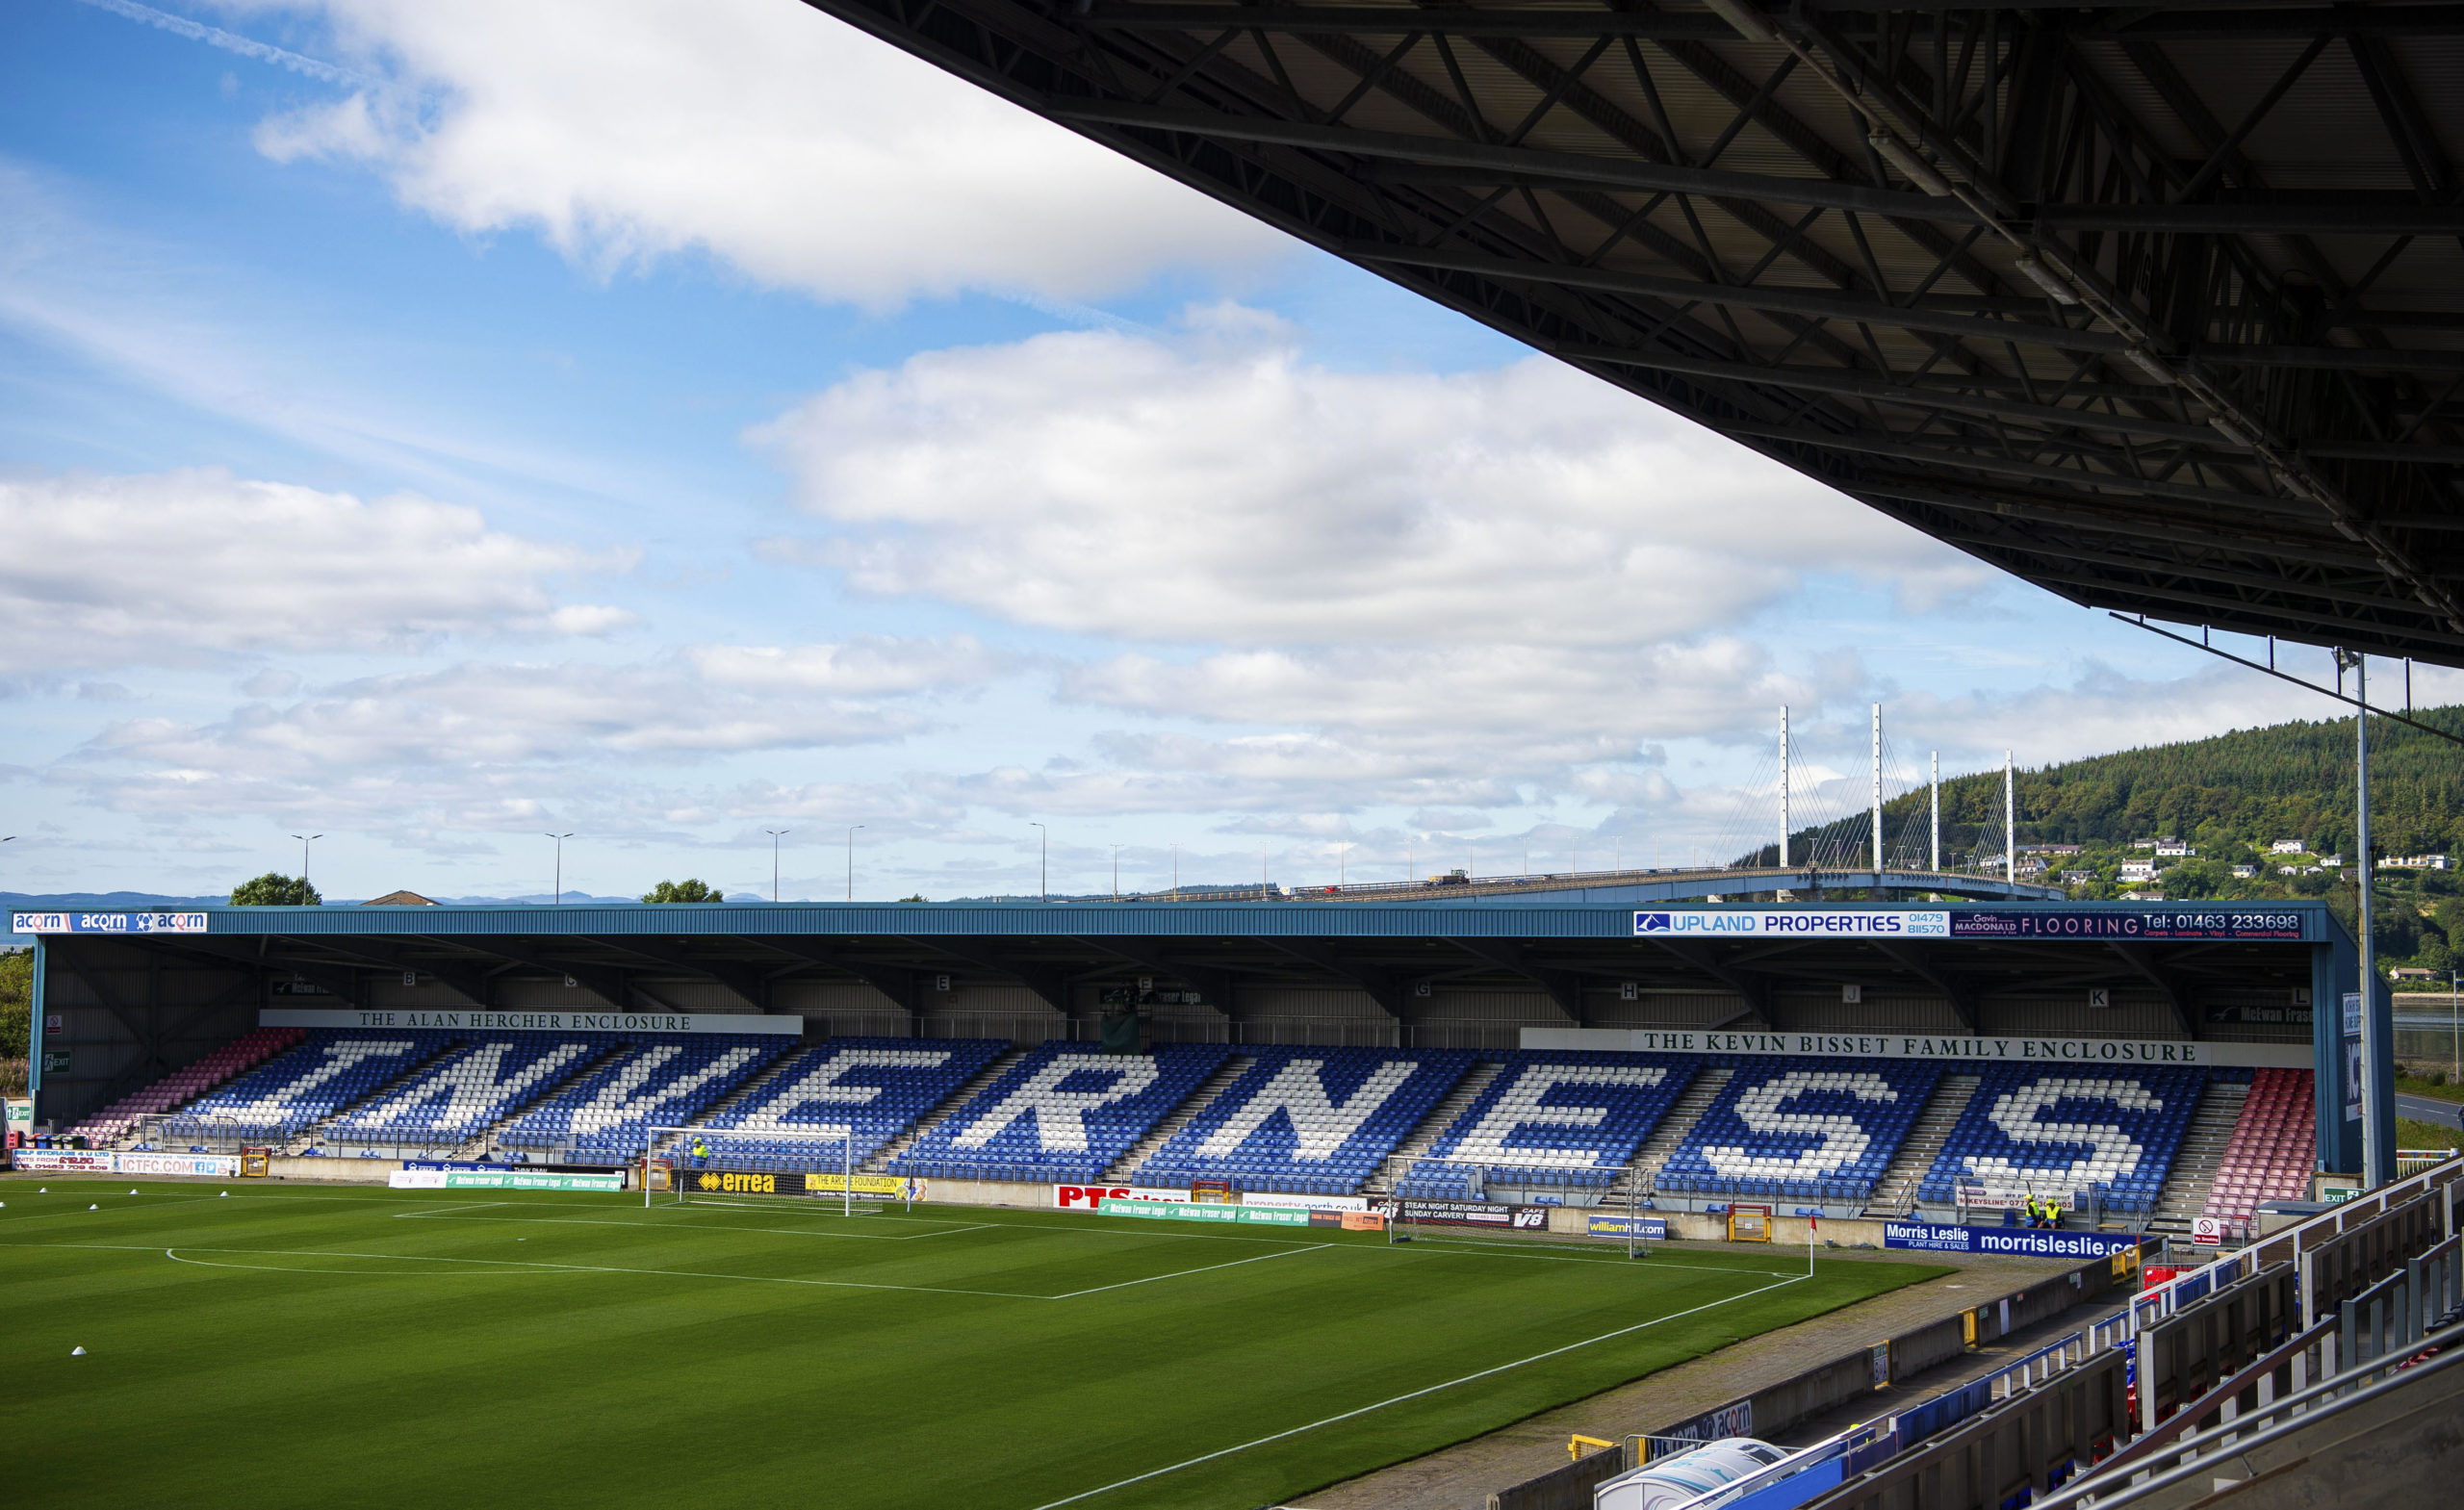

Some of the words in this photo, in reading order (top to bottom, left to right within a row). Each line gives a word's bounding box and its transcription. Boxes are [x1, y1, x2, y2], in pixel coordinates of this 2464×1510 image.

[16, 914, 60, 930] acorn
[81, 913, 126, 930] acorn
[158, 914, 204, 930] acorn
[1674, 915, 1756, 932] UPLAND
[1765, 915, 1901, 932] PROPERTIES
[1909, 913, 1943, 923] 01479
[1973, 914, 1997, 923] Gavin
[2022, 917, 2139, 934] FLOORING
[2143, 914, 2170, 929] Tel:
[2176, 914, 2226, 929] 01463
[2231, 914, 2298, 930] 233698
[1908, 924, 1945, 934] 811570
[405, 973, 414, 985] B
[939, 977, 947, 989] E
[1418, 982, 1428, 995] G
[1624, 985, 1634, 998] H
[2092, 990, 2105, 1005] K
[2296, 989, 2307, 1004] L
[360, 1012, 396, 1025] THE
[406, 1012, 460, 1027] ALAN
[469, 1013, 562, 1029] HERCHER
[571, 1014, 692, 1030] ENCLOSURE
[2241, 1007, 2283, 1022] McEwan
[2286, 1007, 2314, 1022] Frase
[1644, 1033, 1695, 1049] THE
[1706, 1034, 1786, 1052] KEVIN
[1799, 1036, 1889, 1054] BISSET
[1903, 1037, 2010, 1057] FAMILY
[2021, 1040, 2196, 1062] ENCLOSURE
[54, 1058, 69, 1066] EXIT
[122, 1159, 193, 1173] ICTFC.COM
[723, 1172, 775, 1192] errea
[817, 1175, 829, 1185] THE
[831, 1175, 854, 1186] ARCHE
[855, 1176, 897, 1188] FOUNDATION
[1958, 1197, 2008, 1206] "MKEYSLINE"
[2324, 1193, 2346, 1203] EXIT
[1110, 1203, 1132, 1214] McEwan
[1133, 1204, 1151, 1215] Fraser
[1152, 1205, 1166, 1216] Legal
[1178, 1205, 1201, 1217] McEwan
[1202, 1207, 1219, 1218] Fraser
[1220, 1209, 1236, 1220] Legal
[1427, 1202, 1450, 1211] NIGHT
[1450, 1203, 1486, 1212] SATURDAY
[1487, 1205, 1508, 1214] NIGHT
[1249, 1210, 1272, 1221] McEwan
[1273, 1211, 1293, 1221] Fraser
[1294, 1212, 1309, 1223] Legal
[1514, 1213, 1544, 1227] V8
[1589, 1220, 1664, 1235] williamhll.com
[1886, 1224, 1928, 1239] Morris
[1932, 1226, 1969, 1241] Leslie
[1981, 1233, 2137, 1257] morrisleslie.co
[1717, 1402, 1751, 1437] acorn
